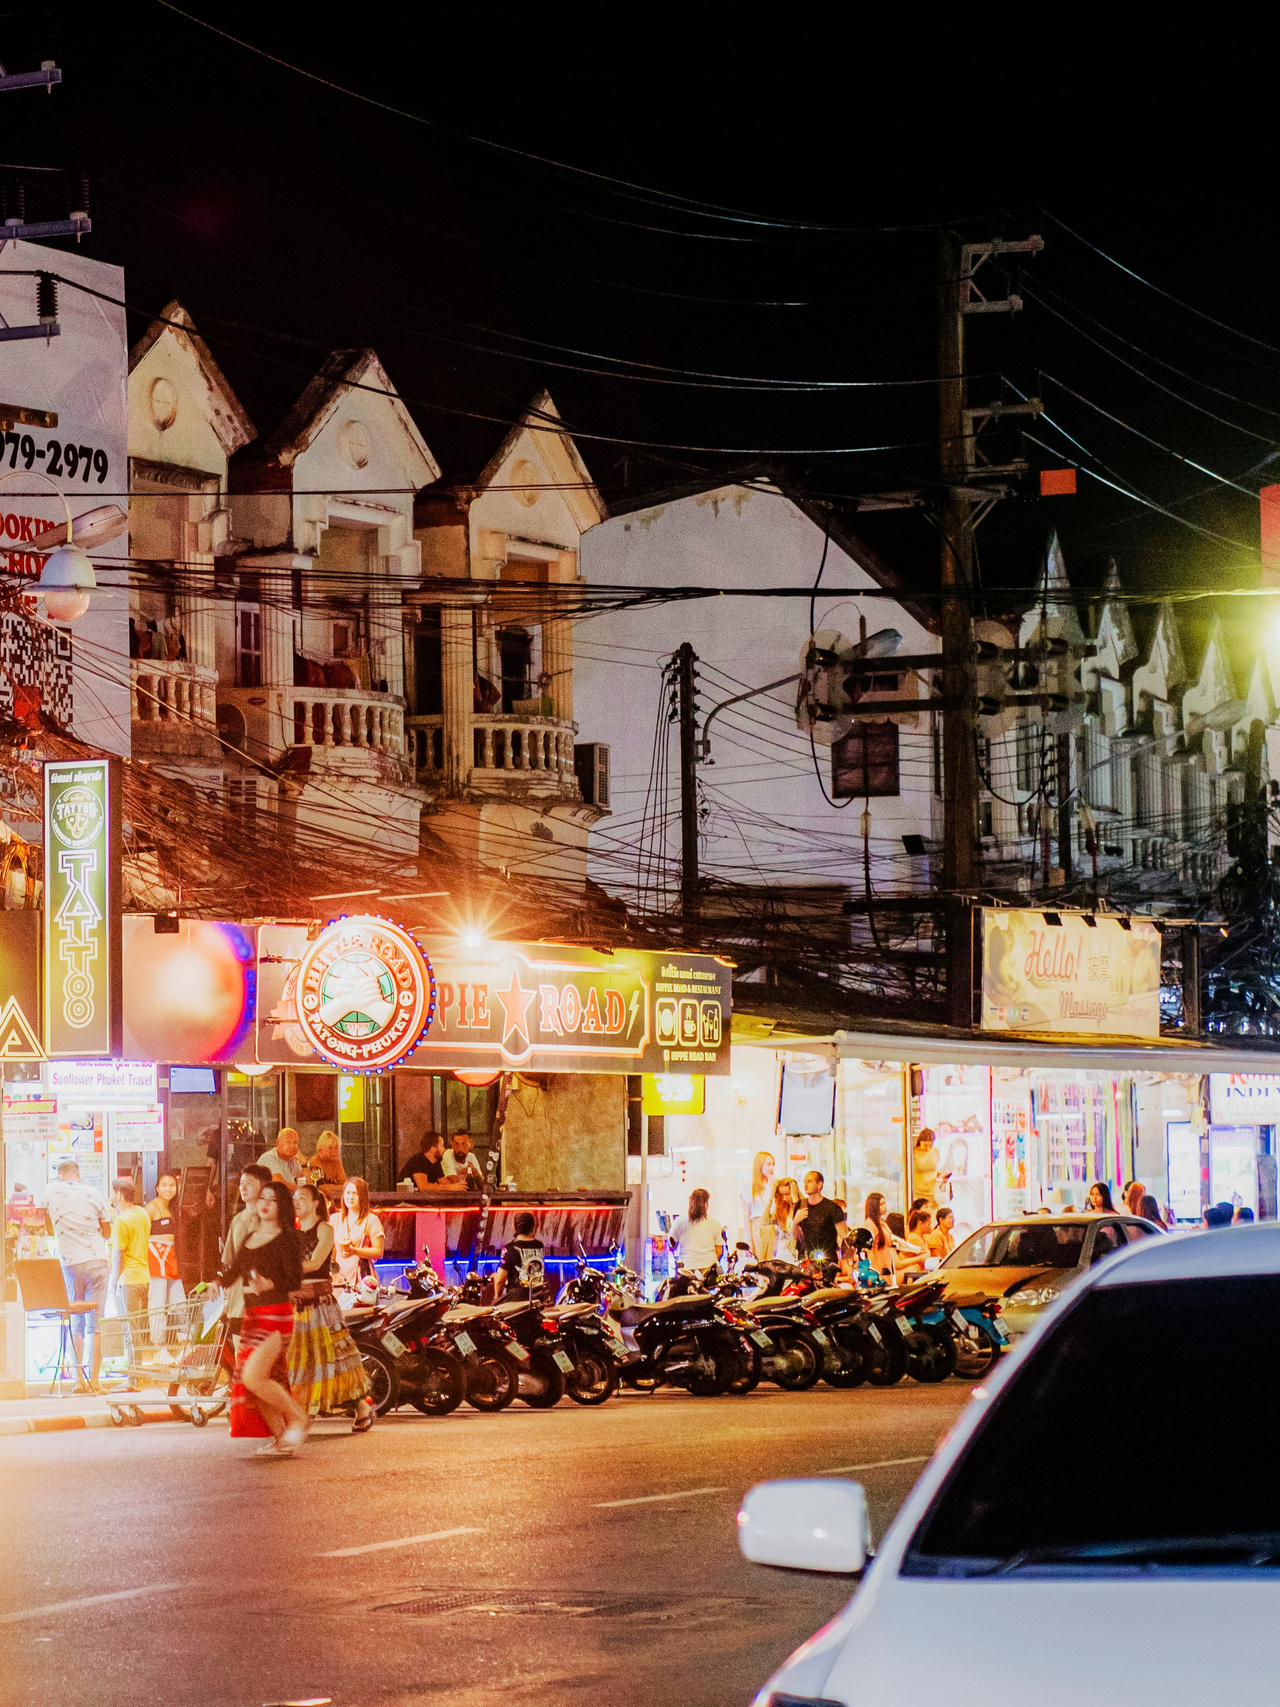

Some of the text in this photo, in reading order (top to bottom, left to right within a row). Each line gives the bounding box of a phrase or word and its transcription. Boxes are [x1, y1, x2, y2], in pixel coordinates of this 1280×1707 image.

[54, 850, 102, 1029] TATTOO
[369, 934, 413, 989] ROAD
[1024, 929, 1083, 982] Hello!
[539, 984, 626, 1036] ROAD
[673, 983, 687, 993] ROAD
[1059, 991, 1109, 1027] Massage
[308, 1008, 410, 1058] PATONG-PHUKET
[671, 1051, 717, 1062] HIPPIE ROAD BAR
[53, 1073, 153, 1086] Sunflower Phuket Travel
